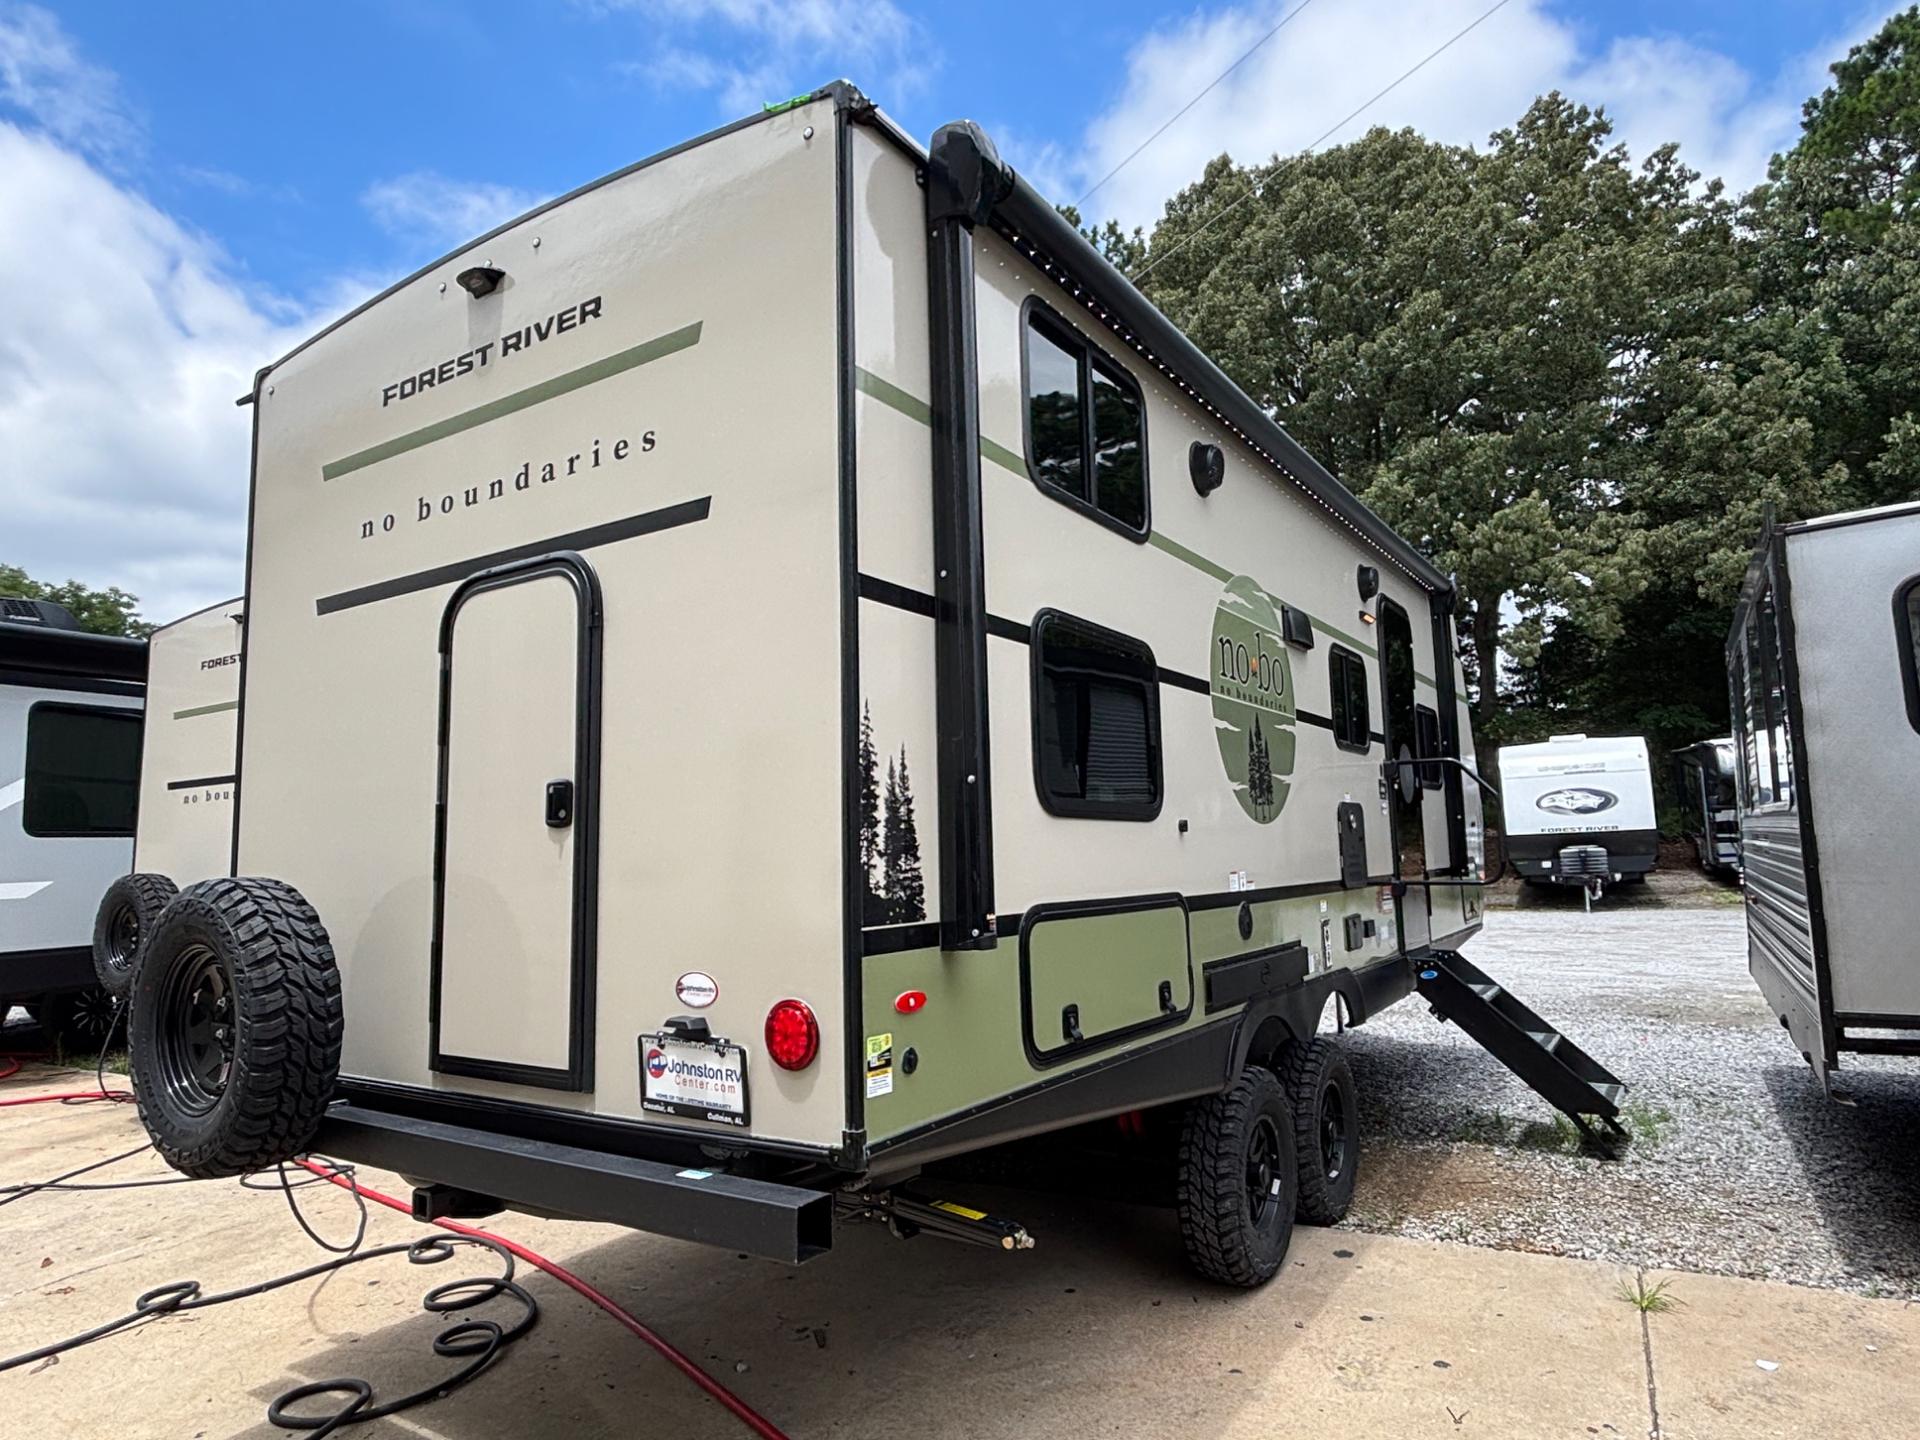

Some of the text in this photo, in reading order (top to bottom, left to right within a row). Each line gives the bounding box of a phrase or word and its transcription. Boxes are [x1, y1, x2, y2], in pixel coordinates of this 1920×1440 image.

[382, 296, 602, 407] FOREST RIVER
[361, 429, 657, 539] no boundaries
[184, 794, 198, 804] no
[668, 1058, 743, 1083] Johnston RV
[674, 1074, 736, 1094] Center.com
